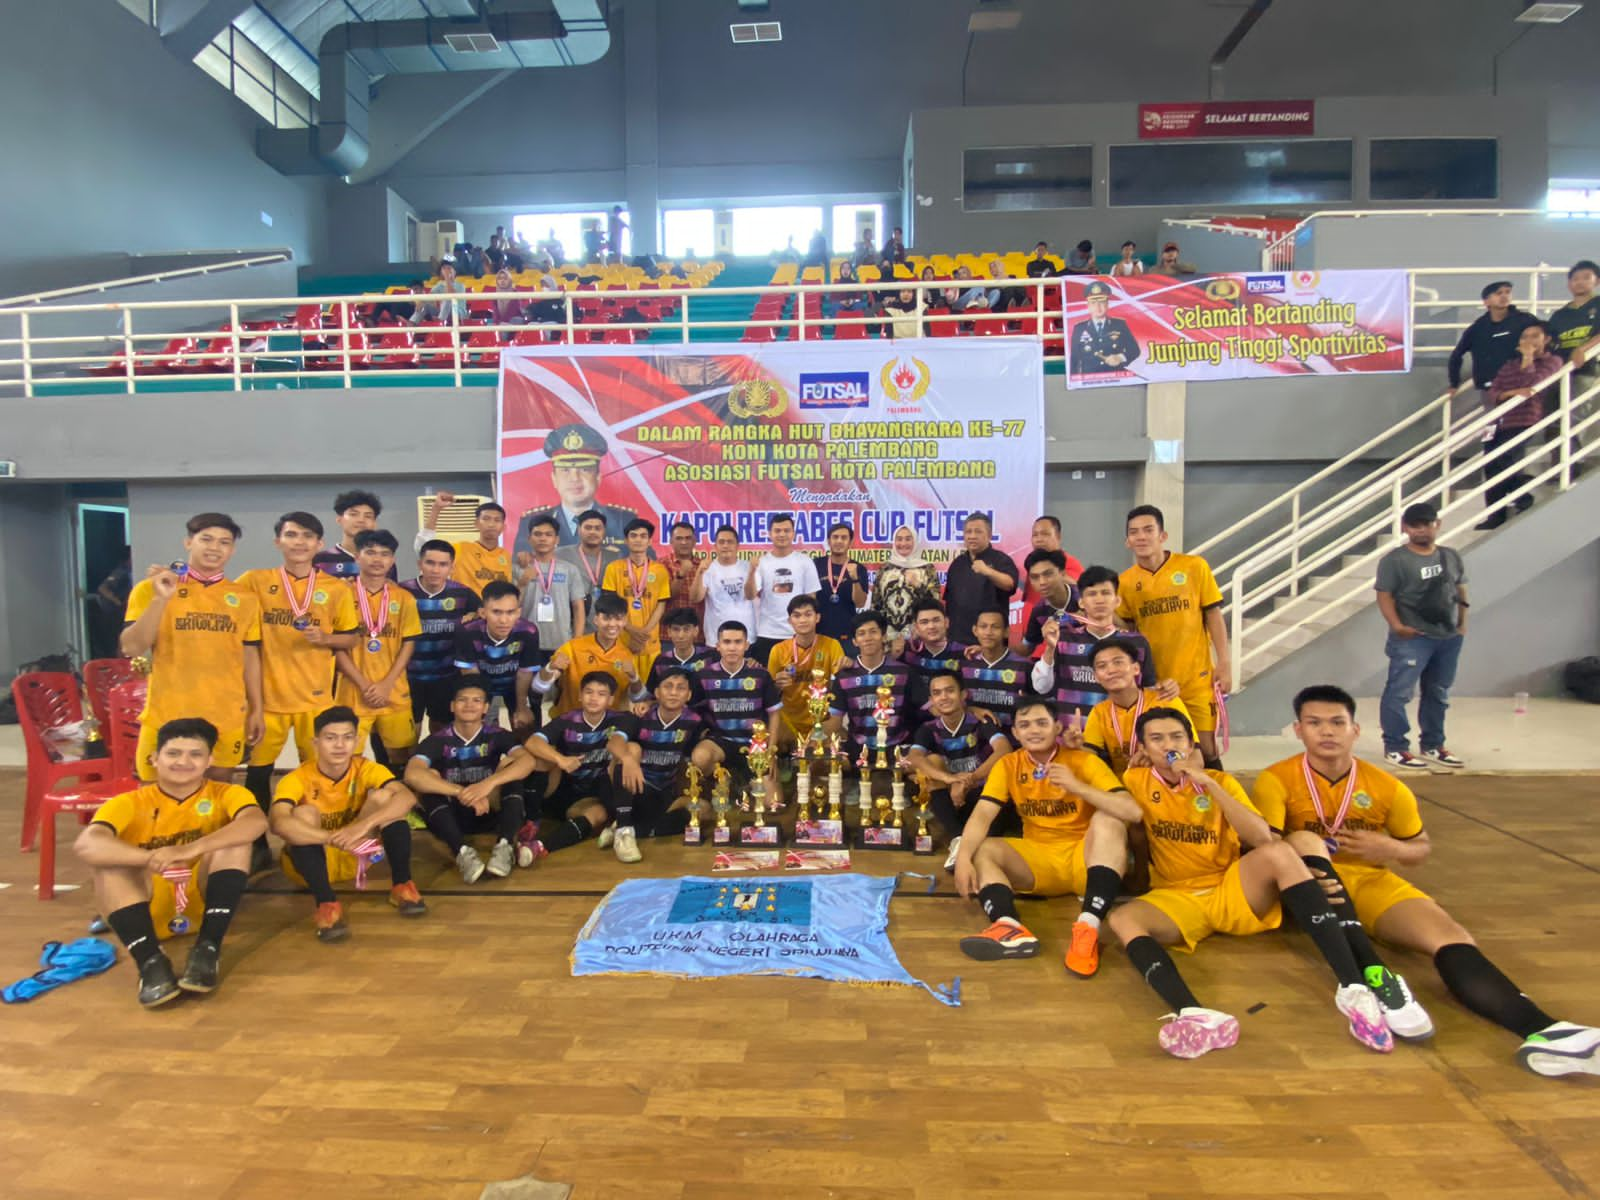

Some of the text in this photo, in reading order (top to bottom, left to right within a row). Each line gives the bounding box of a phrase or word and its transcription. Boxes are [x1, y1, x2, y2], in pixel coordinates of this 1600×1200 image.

[1205, 113, 1247, 124] SELAMAT
[1249, 111, 1310, 122] BERTANDING
[1174, 298, 1356, 330] Selamat Bertanding
[1147, 330, 1387, 367] Junjung Tinggi Sportivitas
[802, 382, 867, 400] FUTSAL
[637, 420, 1026, 442] DALAM RANGKA HUT BHAYANGKARA KE-77
[722, 440, 939, 461] KONI KOTA PALEMBANG
[664, 460, 996, 481] ASOSIASI FUTSAL KOTA PALEMBANG
[790, 488, 870, 506] Mengadakan
[914, 510, 999, 541] FUTSL
[729, 931, 819, 943] OLAHRAGA
[706, 946, 770, 957] NEGERI
